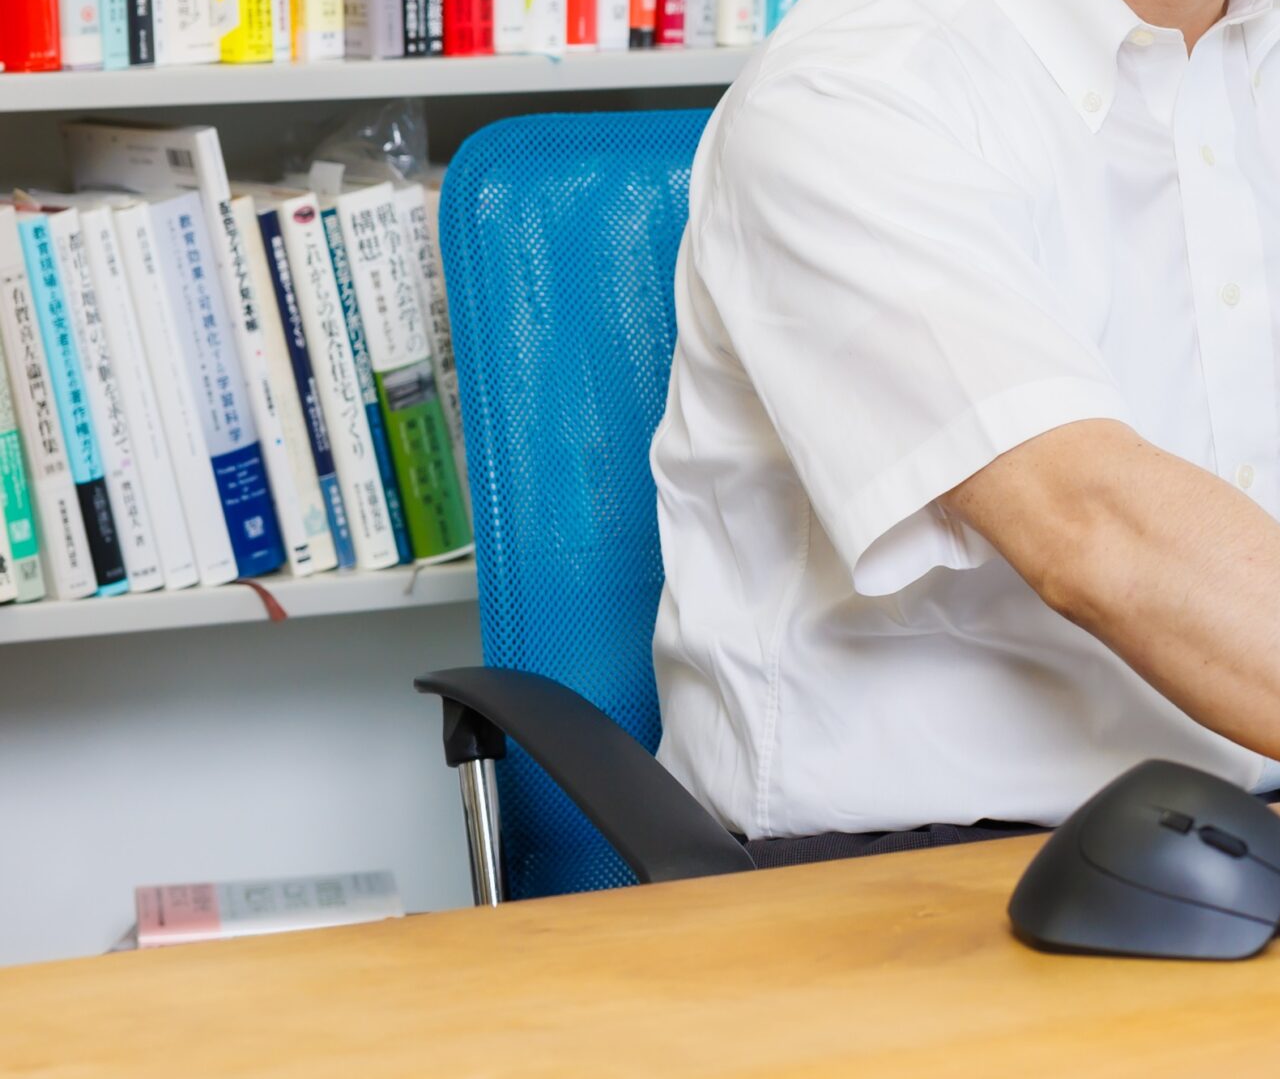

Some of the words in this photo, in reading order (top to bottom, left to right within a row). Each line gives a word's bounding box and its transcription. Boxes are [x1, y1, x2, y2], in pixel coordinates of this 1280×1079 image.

[351, 209, 384, 263] 構想
[376, 202, 426, 353] 戦争社会学の
[33, 224, 99, 477] 教育現場と研究者のための著作権ガイド
